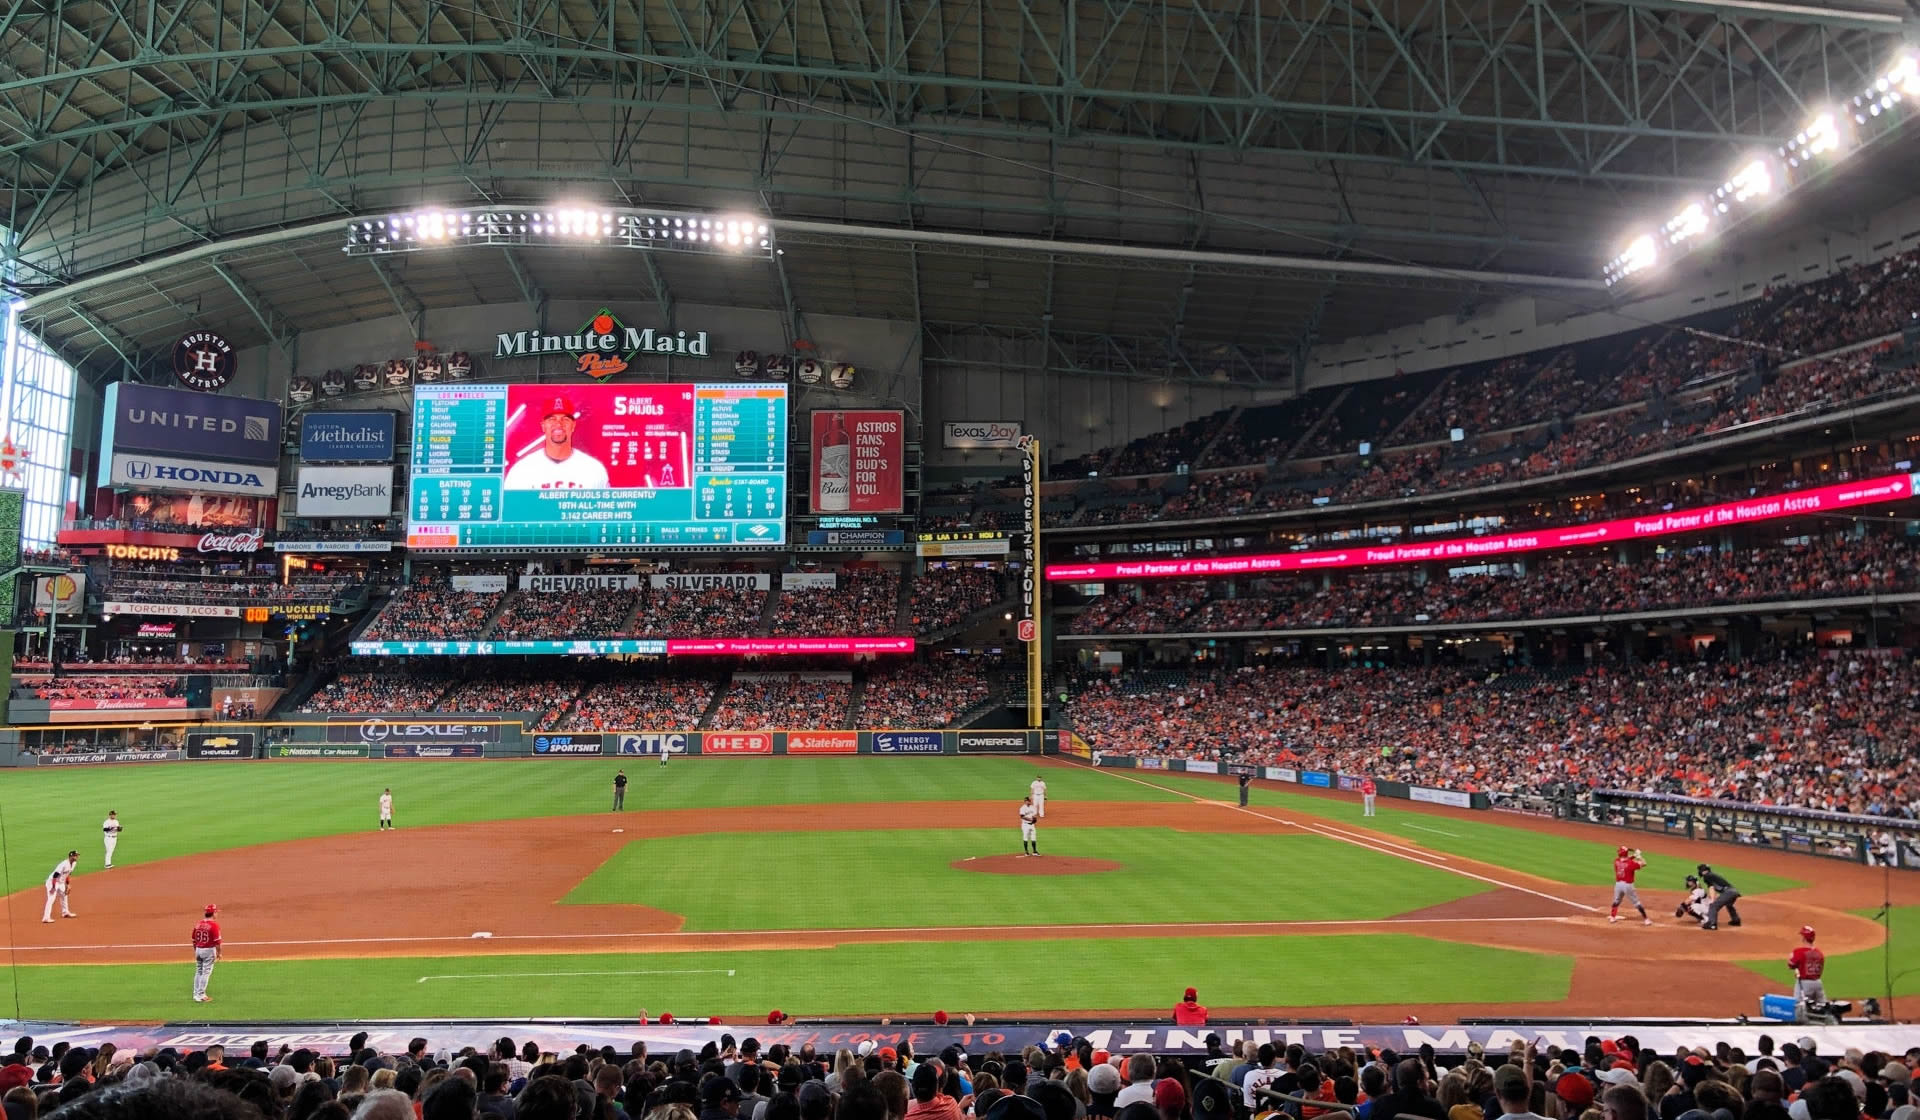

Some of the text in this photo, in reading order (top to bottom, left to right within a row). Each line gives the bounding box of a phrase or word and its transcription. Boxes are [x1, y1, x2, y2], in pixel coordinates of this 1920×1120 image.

[182, 333, 231, 353] HOUSTON
[495, 326, 710, 358] Minute Maid
[195, 350, 218, 372] H
[576, 352, 629, 378] Park
[182, 371, 226, 388] ASTROS
[614, 396, 627, 415] 5
[629, 397, 653, 405] ALBERT
[628, 404, 664, 416] PUJOLS
[128, 408, 237, 433] UNITED
[856, 421, 896, 433] ASTROS
[308, 427, 385, 442] Methodist
[949, 423, 1017, 440] Texas Bay
[856, 434, 885, 447] FANS,
[855, 446, 880, 458] THIS
[855, 458, 888, 470] BUD'S
[155, 465, 264, 488] HONDA
[855, 471, 876, 483] FOR
[439, 480, 472, 488] BATTING
[855, 484, 880, 495] YOU.
[301, 482, 386, 500] AmegyBank
[538, 491, 657, 499] ALBERT PUJOLS IS CURRENTLY
[578, 501, 615, 509] ALL-TIME
[617, 501, 637, 509] WITH
[1022, 458, 1033, 545] BURGERZ
[582, 511, 613, 519] CAREER
[614, 511, 632, 519] HITS
[1634, 495, 1820, 534] Proud Partner of the Houston Astros
[1367, 537, 1538, 561] Proud Partner of the Houston Astros
[1116, 559, 1281, 575] Proud Partner of the Houston Astros
[530, 577, 628, 592] CHEVROLET
[665, 576, 757, 591] SILVERADO
[1023, 566, 1033, 618] FOUL
[186, 607, 218, 615] TACOS
[272, 605, 331, 613] PLUCKERS
[96, 699, 146, 709] Budweiser
[392, 724, 489, 736] LEXUS 373
[550, 737, 572, 745] AT&T
[620, 734, 686, 753] RTIC
[713, 738, 763, 748] H-E-B
[960, 738, 1023, 746] POWERADE
[288, 747, 321, 756] National
[550, 744, 600, 752] SPORTSNET
[899, 744, 938, 752] TRANSFER
[757, 1032, 1005, 1046] WELCOME TO
[1046, 1028, 1365, 1050] MINUTE
